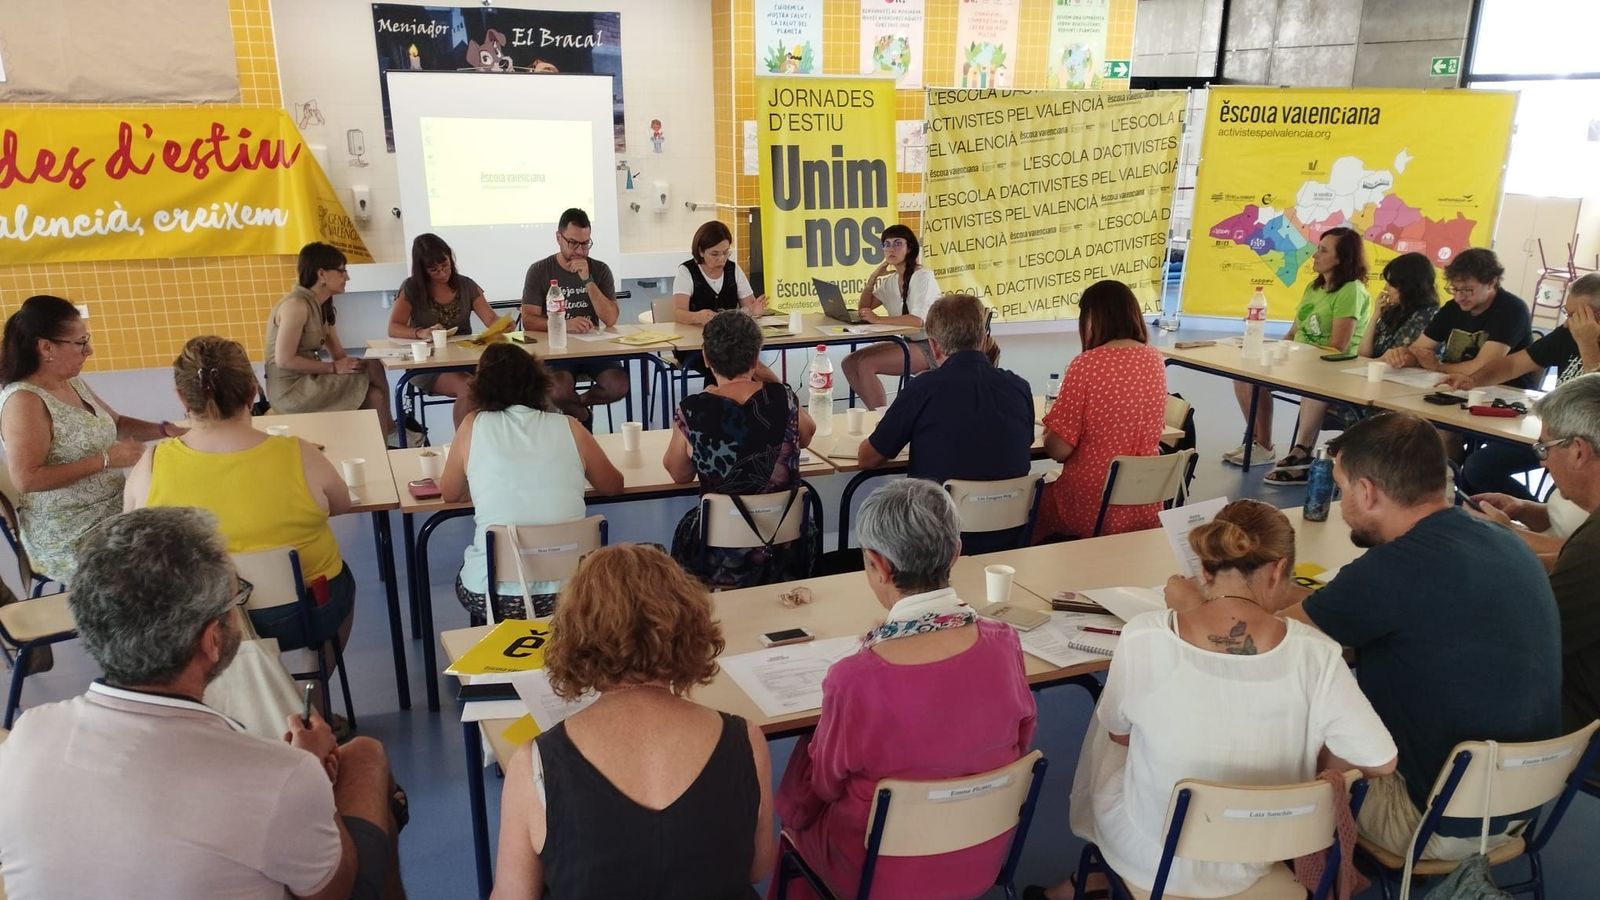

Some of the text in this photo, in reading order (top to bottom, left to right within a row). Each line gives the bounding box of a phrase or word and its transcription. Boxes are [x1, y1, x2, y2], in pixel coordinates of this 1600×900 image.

[377, 18, 450, 39] Menjador
[511, 28, 604, 48] El Bracal
[768, 88, 875, 108] JORNADES
[928, 89, 998, 106] L'ESCOLA
[769, 113, 844, 132] D'ESTIU
[925, 110, 1004, 133] ACTIVISTES
[1007, 107, 1034, 123] PEL
[1036, 95, 1104, 118] VALENCIÀ
[1282, 105, 1381, 125] valenciana
[948, 131, 1018, 155] VALENCIÀ
[1111, 111, 1175, 132] L'ESCOLA
[1218, 127, 1332, 140] activistespelvalencia.org
[105, 121, 302, 181] d'estiu
[1023, 149, 1089, 171] L'ESCOLA
[1093, 136, 1178, 161] D'ACTIVISTES
[507, 172, 546, 183] valenciana
[770, 145, 889, 212] Unim
[928, 158, 1179, 209] L'ESCOLA D'ACTIVISTES PEL VALENCIÀ
[925, 210, 1002, 233] ACTIVISTES
[1005, 207, 1031, 221] PEL
[1033, 194, 1099, 217] VALENCIÀ
[786, 216, 886, 268] -nos
[940, 232, 1008, 255] VALENCIÀ
[1098, 209, 1158, 231] L'ESCOLA
[1018, 247, 1082, 268] L'ESCOLA
[1085, 232, 1167, 257] D'ACTIVISTES
[996, 270, 1081, 296] D'ACTIVISTES
[1084, 266, 1108, 283] PEL
[1002, 302, 1027, 318] PEL
